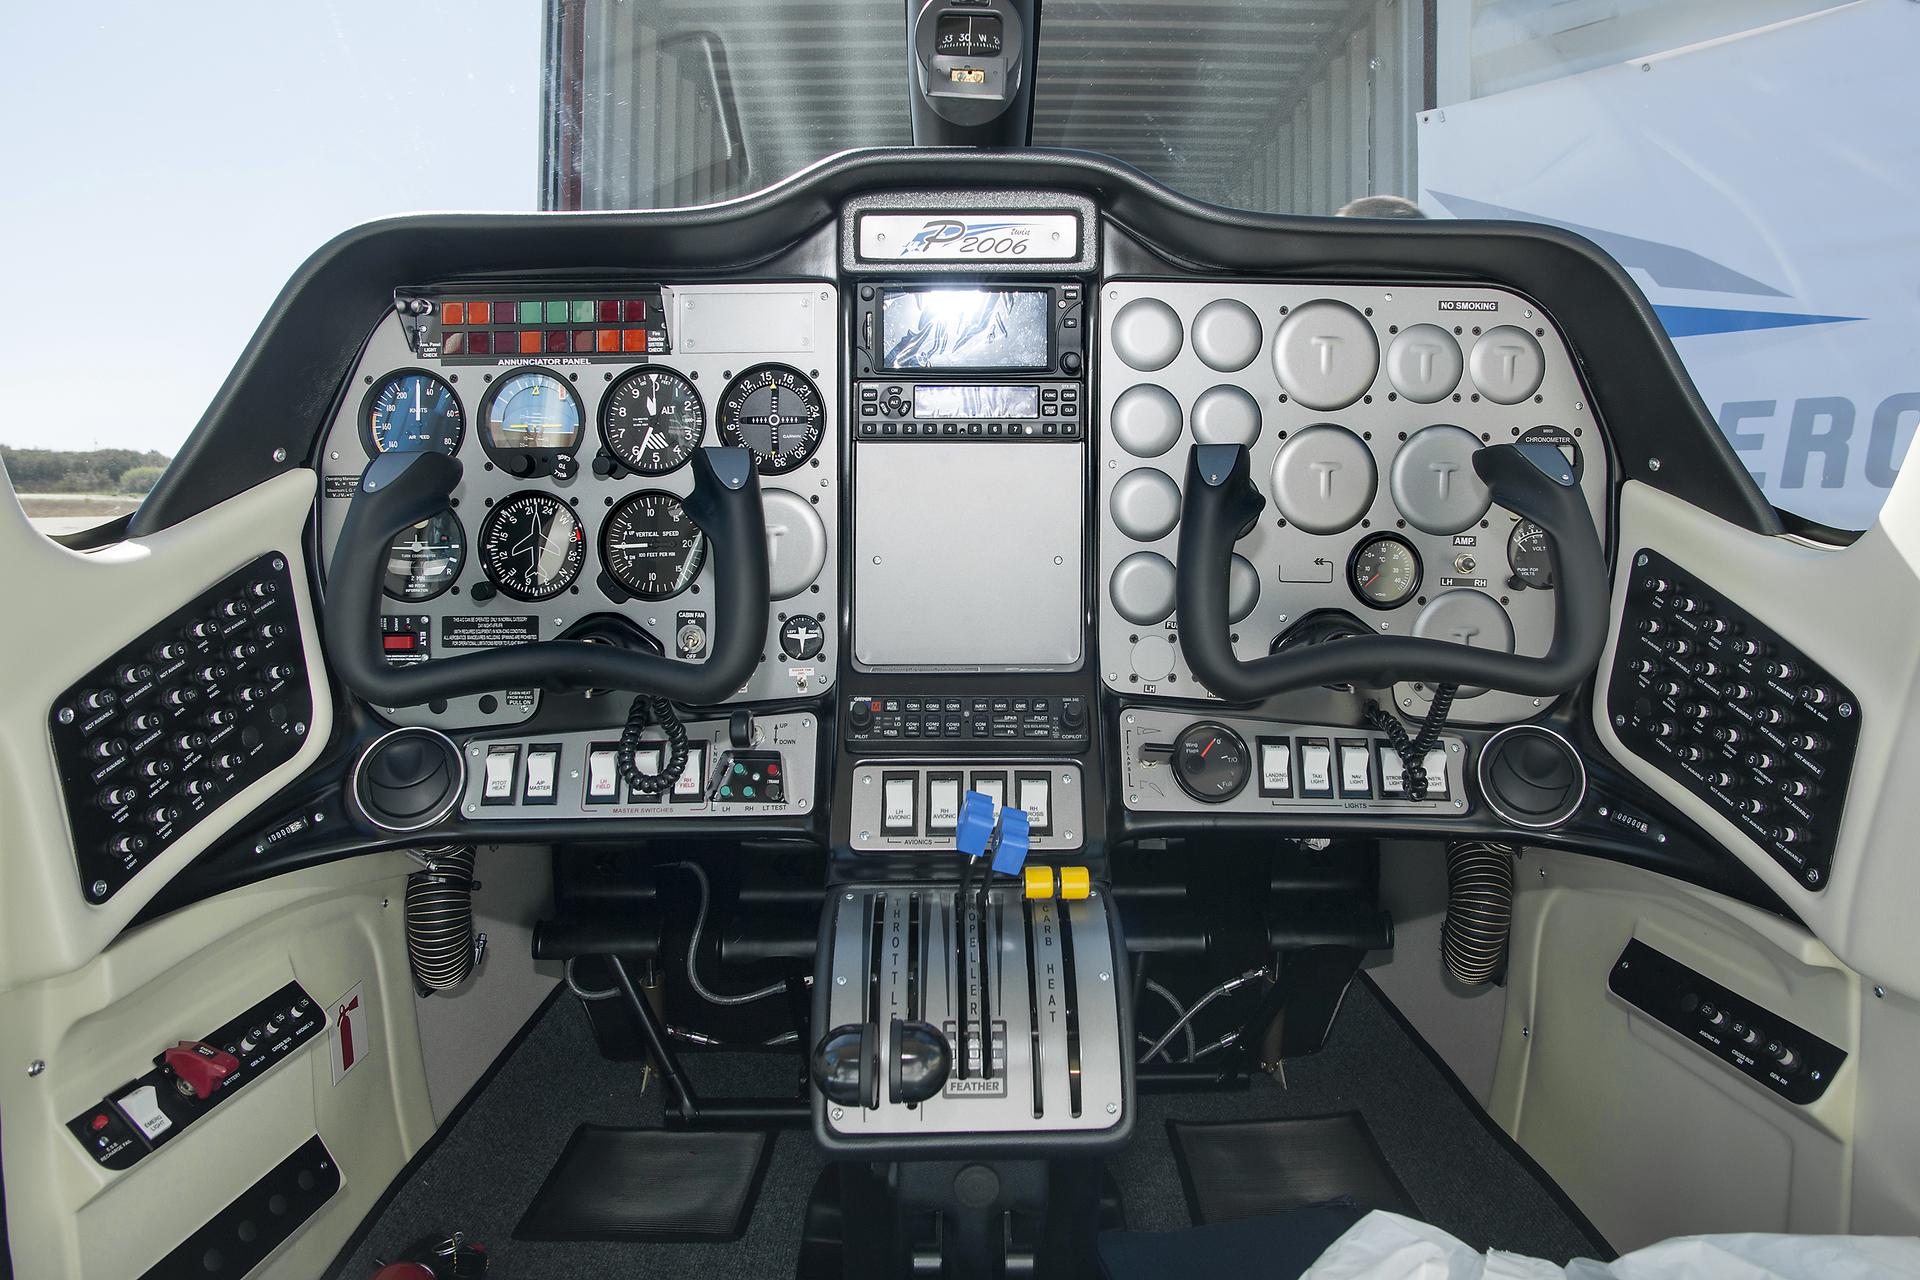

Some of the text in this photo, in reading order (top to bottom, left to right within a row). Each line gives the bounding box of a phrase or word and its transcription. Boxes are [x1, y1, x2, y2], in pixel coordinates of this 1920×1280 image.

[942, 34, 987, 44] 33 30 W
[760, 372, 772, 381] 15
[783, 373, 794, 384] 18
[740, 380, 753, 392] 12
[799, 384, 812, 397] 21
[632, 388, 640, 398] 9
[661, 406, 676, 414] ALT
[684, 400, 692, 410] 2
[619, 407, 626, 417] 8
[810, 405, 820, 418] 24
[618, 428, 626, 438] 7
[684, 430, 692, 440] 3
[808, 427, 818, 441] 27
[632, 446, 640, 455] 6
[673, 444, 681, 454] 4
[794, 446, 806, 459] 30
[652, 452, 660, 462] 5
[774, 457, 786, 467] 33
[524, 506, 534, 515] 21
[542, 506, 553, 515] 24
[647, 509, 654, 517] 10
[509, 516, 517, 524] S
[560, 514, 569, 525] W
[500, 532, 508, 541] 15
[568, 532, 577, 542] 30
[500, 550, 508, 560] 12
[568, 550, 577, 562] 33
[508, 568, 517, 576] E
[559, 568, 568, 577] N
[125, 790, 135, 800] 20
[112, 805, 128, 819] LANDING
[118, 812, 129, 823] GEAR
[1042, 905, 1056, 1022] CARB HEAT
[1734, 1024, 1742, 1032] 35
[223, 1072, 240, 1086] BATTERY
[950, 1081, 1000, 1091] FEATHER
[144, 1115, 163, 1128] EMERG
[151, 1120, 165, 1131] LIGHT
